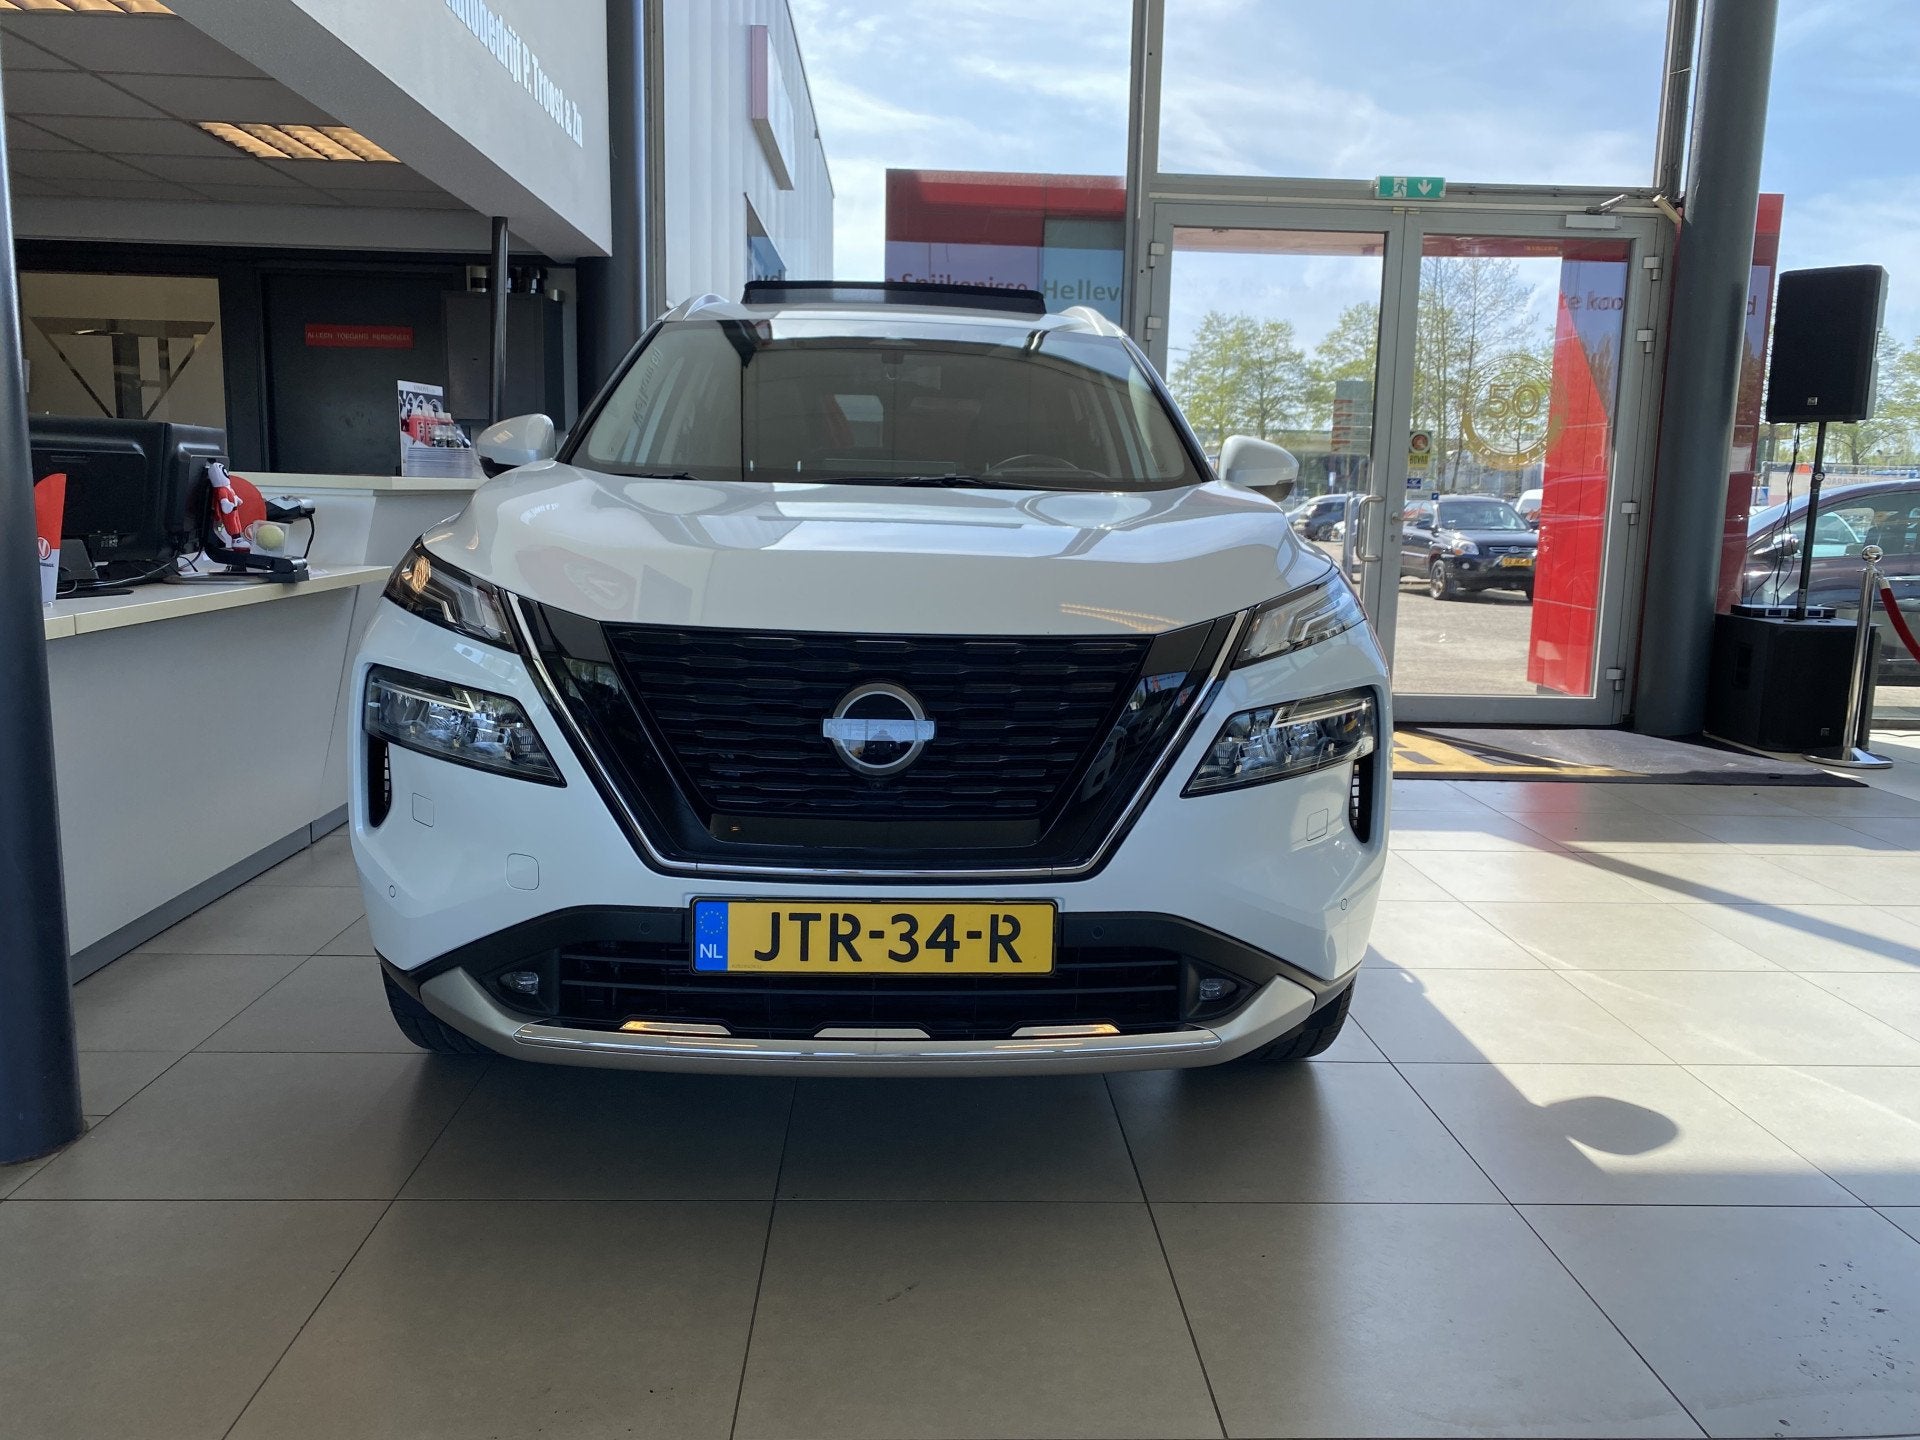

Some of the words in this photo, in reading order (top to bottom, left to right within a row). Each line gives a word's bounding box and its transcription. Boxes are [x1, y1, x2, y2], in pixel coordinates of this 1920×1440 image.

[445, 0, 522, 83] utobedrijf
[531, 52, 565, 129] Troost
[1488, 384, 1541, 419] 50
[699, 943, 723, 960] NL
[753, 911, 1023, 964] JTR-34-R
